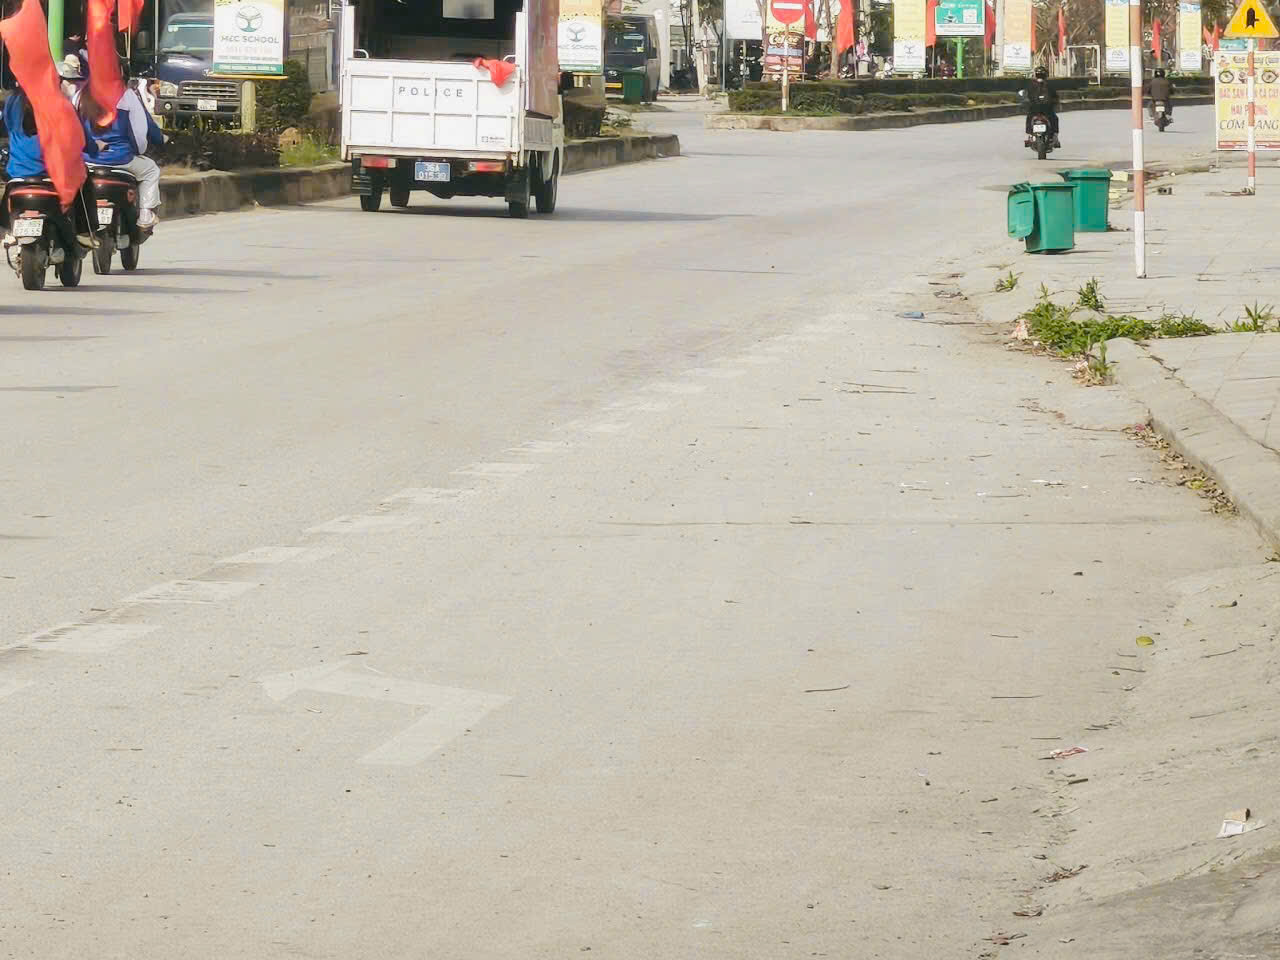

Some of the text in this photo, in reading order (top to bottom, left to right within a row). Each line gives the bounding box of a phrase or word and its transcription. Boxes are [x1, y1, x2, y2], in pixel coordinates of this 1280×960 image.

[242, 35, 280, 44] SCHOOL
[398, 85, 464, 98] POLICE
[1254, 119, 1279, 130] ANG
